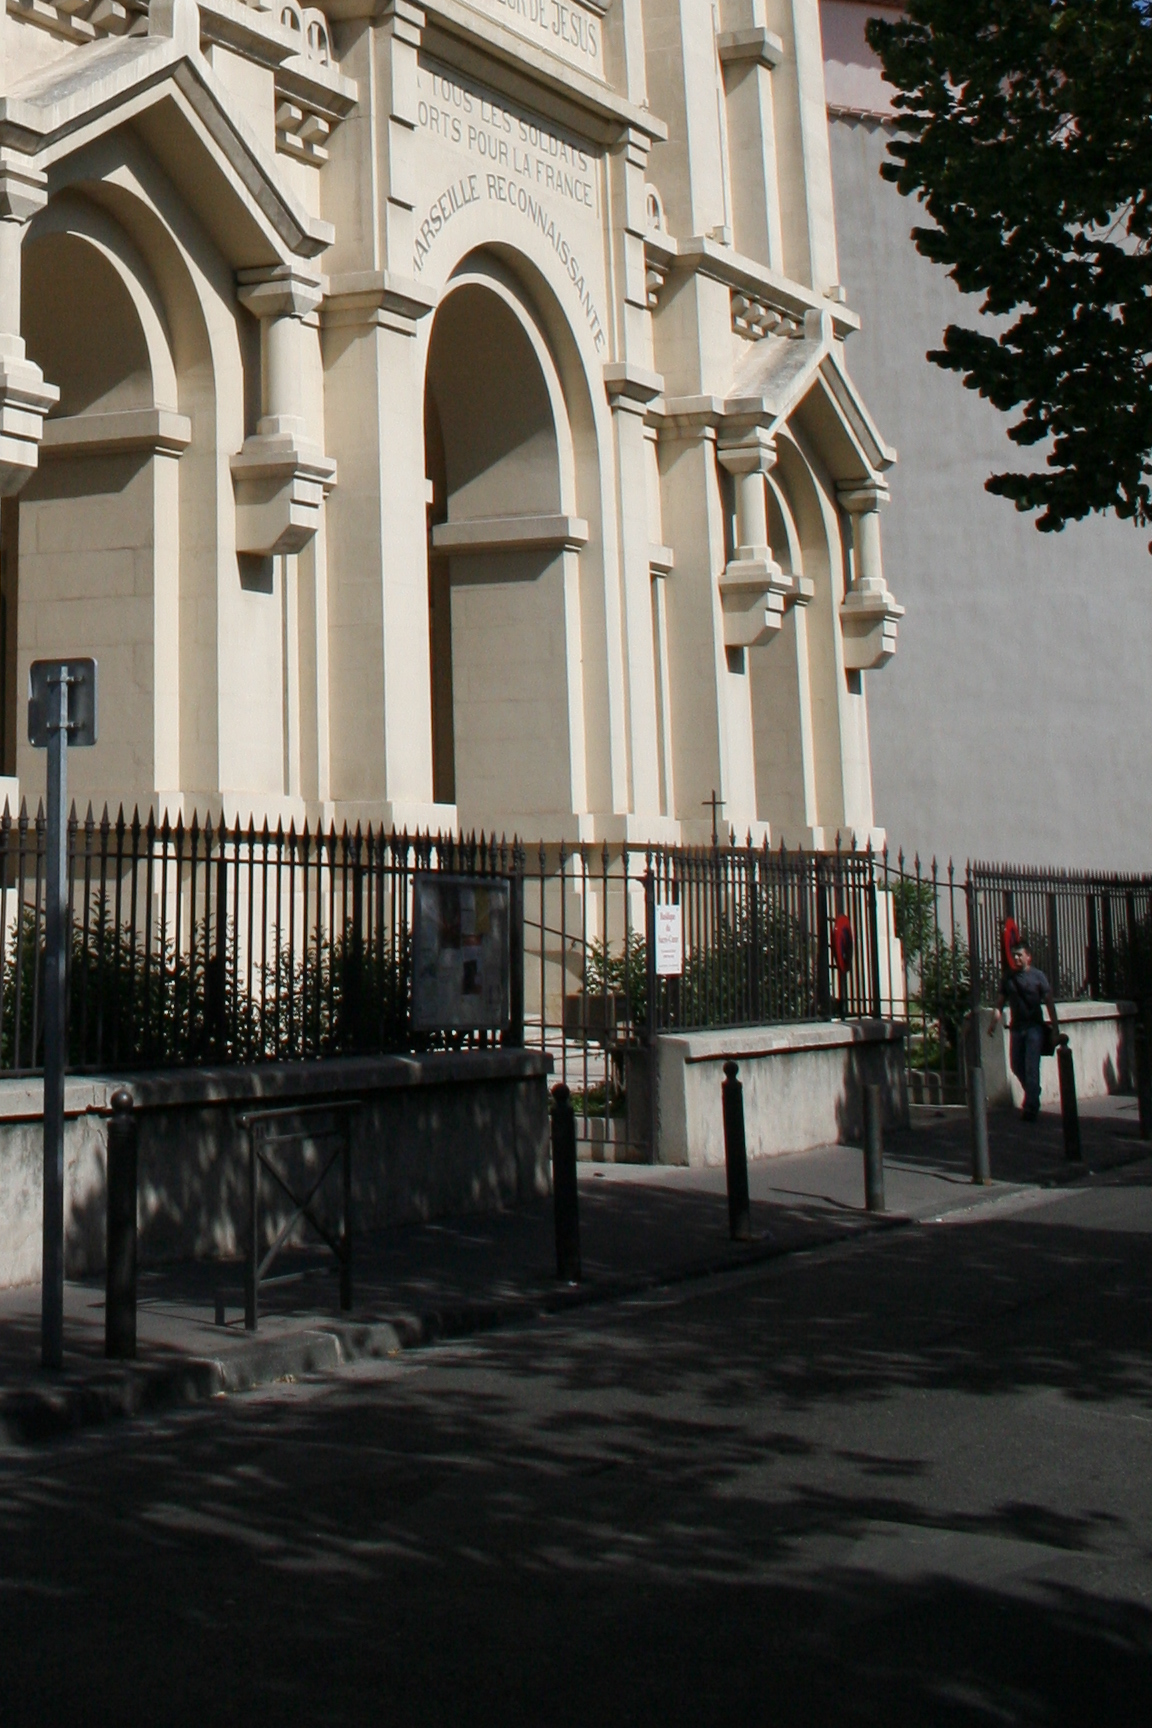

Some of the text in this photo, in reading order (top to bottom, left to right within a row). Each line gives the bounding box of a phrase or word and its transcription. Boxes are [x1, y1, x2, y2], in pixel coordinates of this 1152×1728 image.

[551, 0, 598, 57] JESUS
[418, 100, 592, 208] ORTS POUR LA FRANCE
[431, 73, 588, 172] TOUS LES SOLDATS
[486, 173, 606, 353] RECONNAISSANTE
